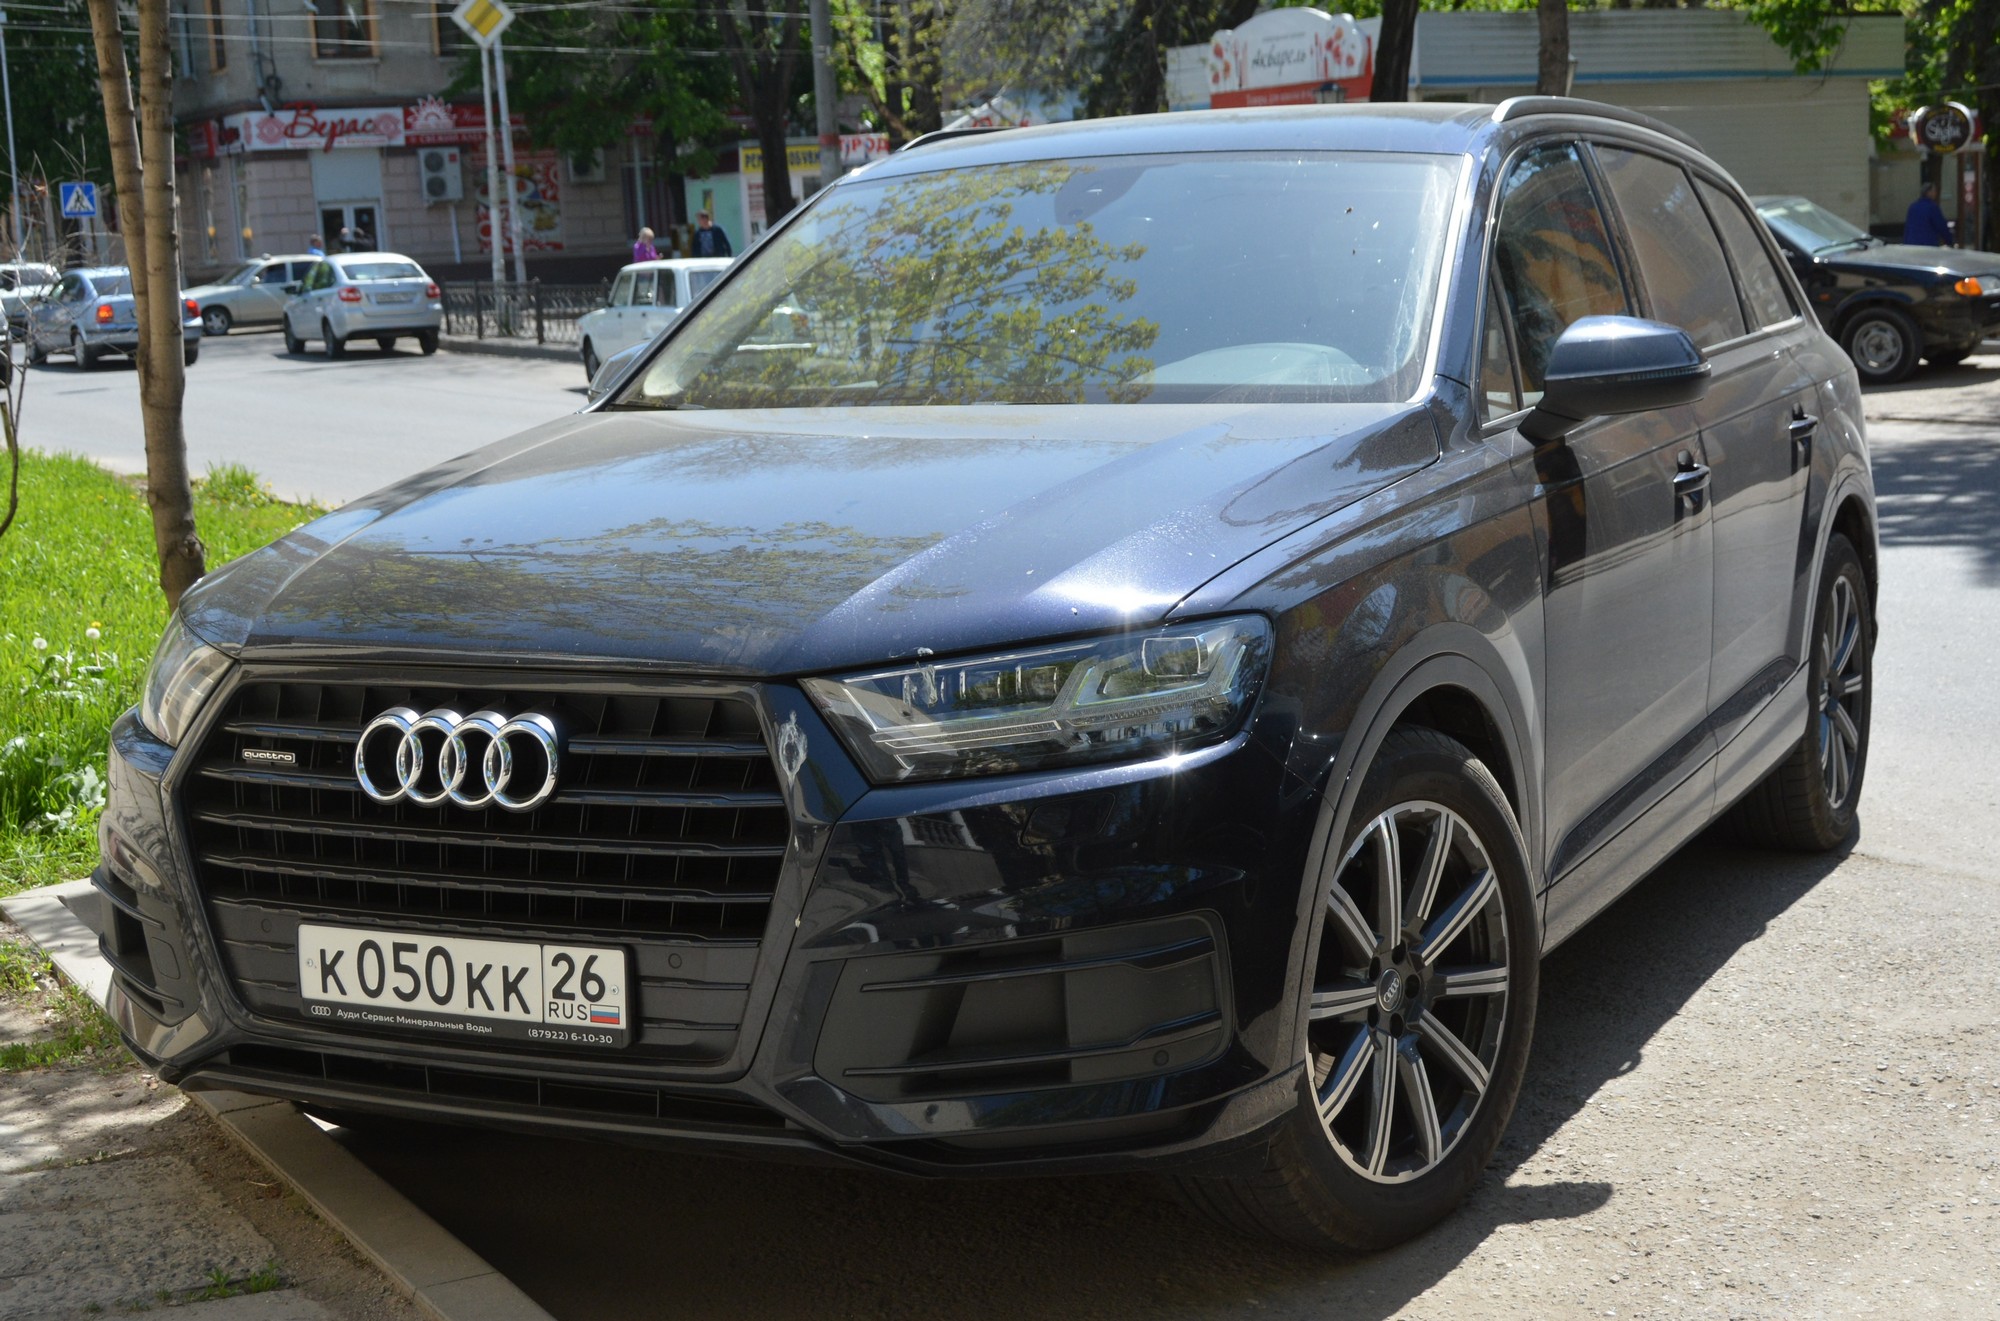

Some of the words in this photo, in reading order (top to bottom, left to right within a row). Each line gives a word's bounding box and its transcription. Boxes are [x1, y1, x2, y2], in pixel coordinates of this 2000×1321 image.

[283, 101, 376, 153] Верас
[244, 751, 292, 761] quattro
[551, 952, 606, 1003] 26
[336, 1008, 360, 1020] Ауди
[361, 1011, 395, 1023] Сервис
[396, 1013, 464, 1030] Минеральные
[466, 1023, 493, 1033] Воды
[548, 1001, 588, 1021] RUS
[528, 1028, 569, 1041] (87922)
[571, 1032, 613, 1044] 6-10-30
